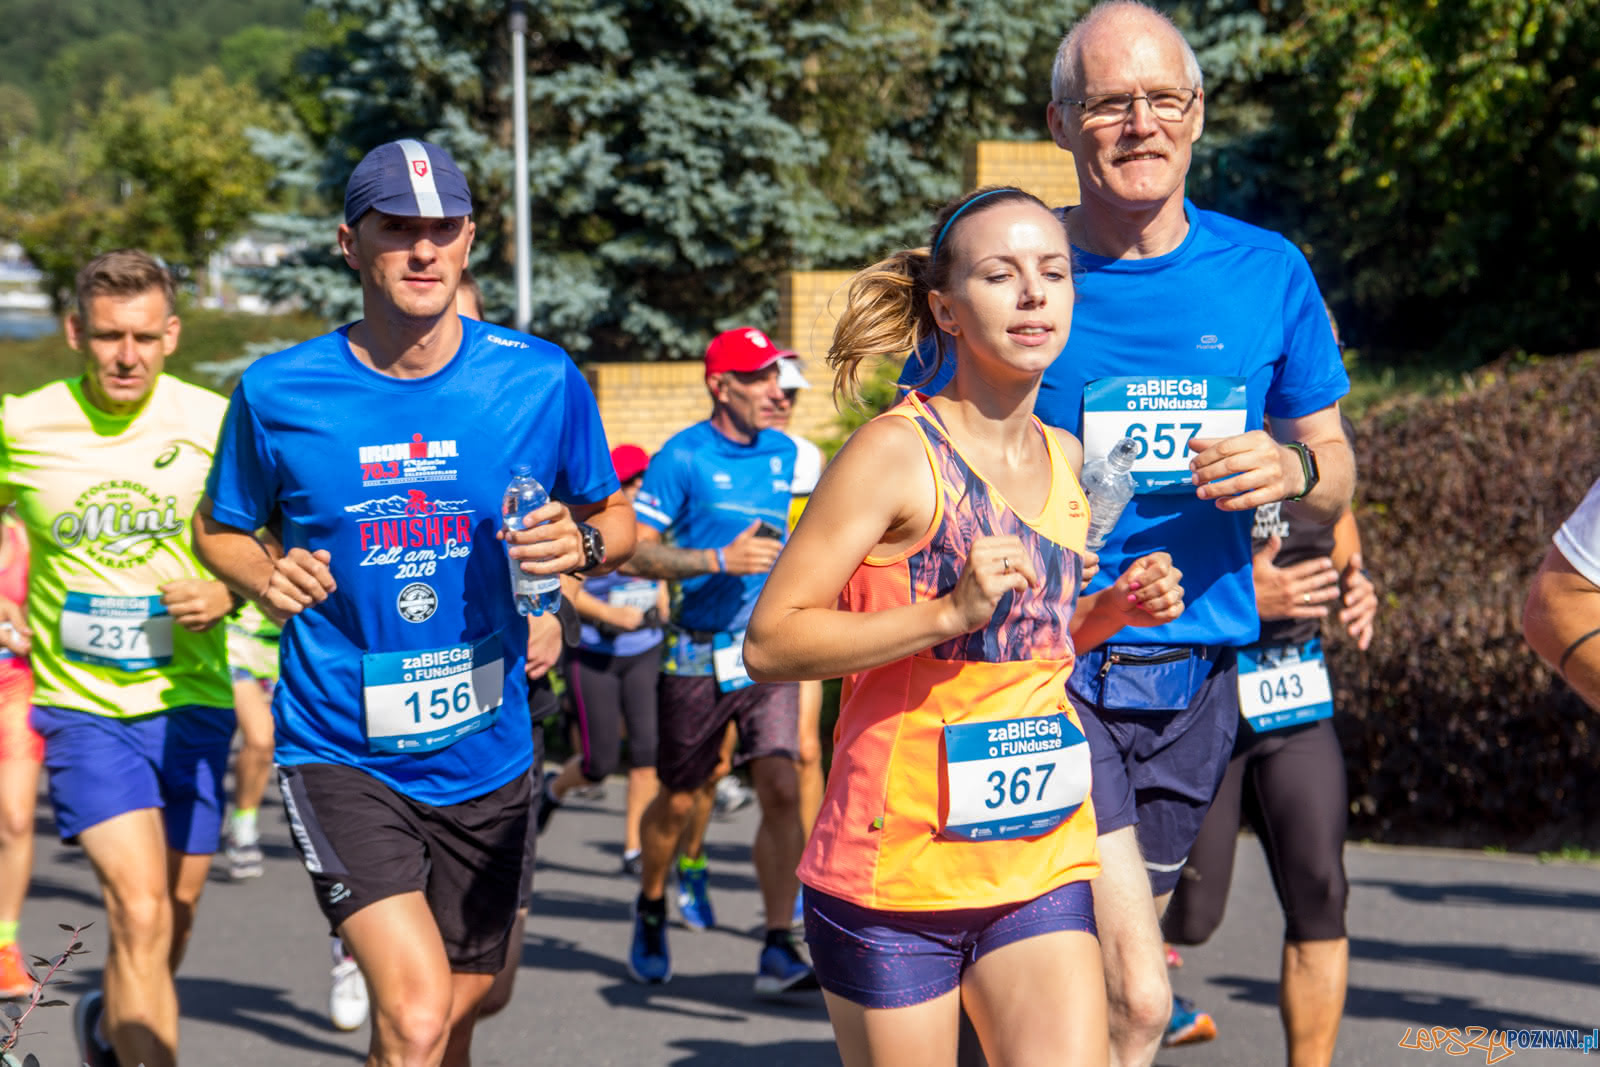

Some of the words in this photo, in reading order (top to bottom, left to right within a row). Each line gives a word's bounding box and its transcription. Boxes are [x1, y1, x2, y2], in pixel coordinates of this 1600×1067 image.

[488, 335, 520, 348] CRAFT
[1126, 380, 1208, 398] zaBIEGaj
[1127, 400, 1136, 410] o
[1140, 398, 1208, 410] FUNdusze
[359, 434, 457, 464] IRONMAN
[1124, 422, 1202, 460] 657
[361, 461, 400, 480] 70.3
[75, 480, 160, 507] STOCKHOLM
[53, 496, 185, 549] Mini
[360, 515, 471, 551] FINISHER
[360, 545, 403, 566] Zell
[404, 549, 437, 562] am
[439, 538, 471, 559] See
[394, 561, 437, 579] 2018
[88, 624, 145, 650] 237
[402, 645, 473, 669] zaBIEGaj
[404, 673, 413, 681] o
[416, 662, 473, 680] FUNdusze
[1260, 674, 1303, 704] 043
[405, 682, 471, 723] 156
[988, 718, 1062, 742] zaBIEGaj
[989, 747, 998, 756] o
[1001, 739, 1062, 755] FUNdusze
[985, 763, 1056, 809] 367
